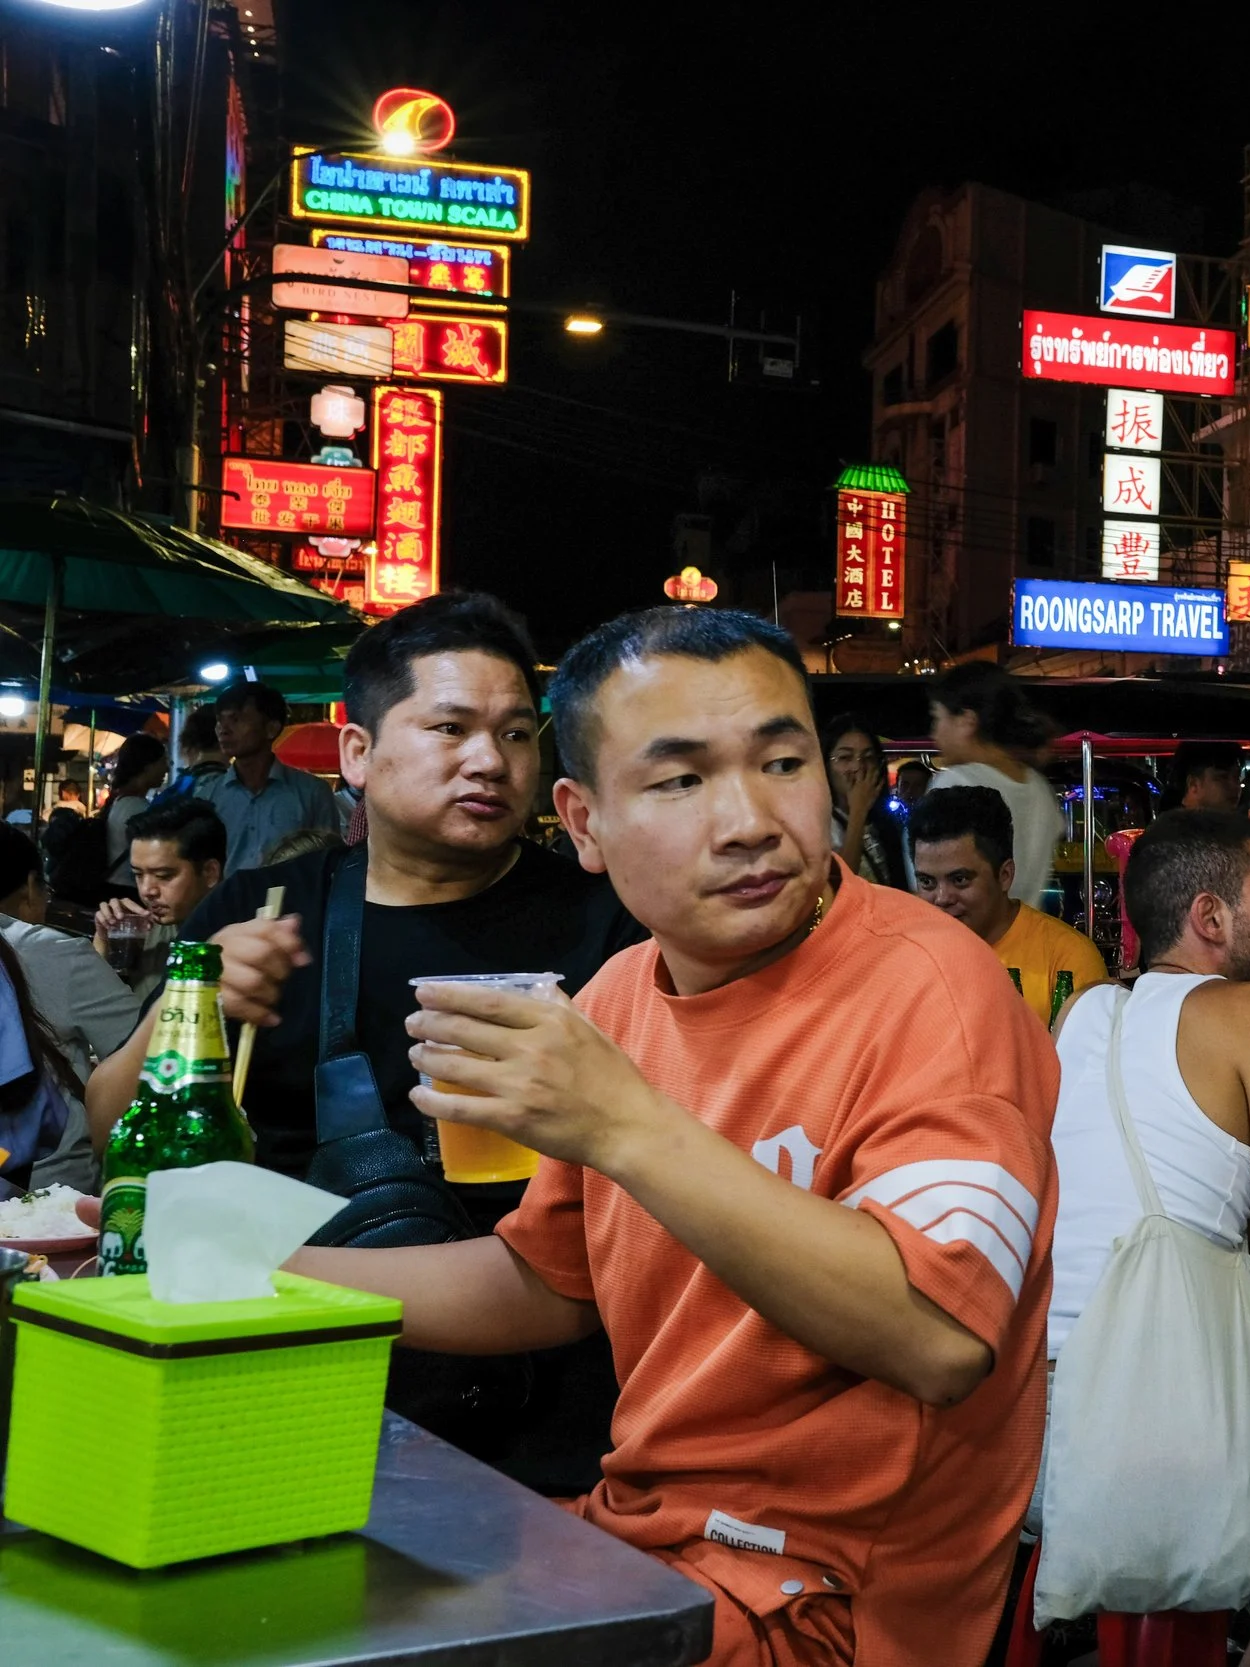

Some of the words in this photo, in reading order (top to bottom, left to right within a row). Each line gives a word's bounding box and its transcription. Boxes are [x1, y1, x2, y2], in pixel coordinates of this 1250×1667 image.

[305, 189, 374, 215] CHINA
[378, 197, 443, 221] TOWN
[447, 204, 517, 230] SCALA
[1029, 323, 1229, 380] รุ่งทรัพย์การท่องเที่ยว
[844, 498, 865, 609] 中國大酒店
[881, 501, 895, 610] HOTEL
[1020, 594, 1145, 637] ROONGSARP
[1151, 601, 1223, 640] TRAVEL
